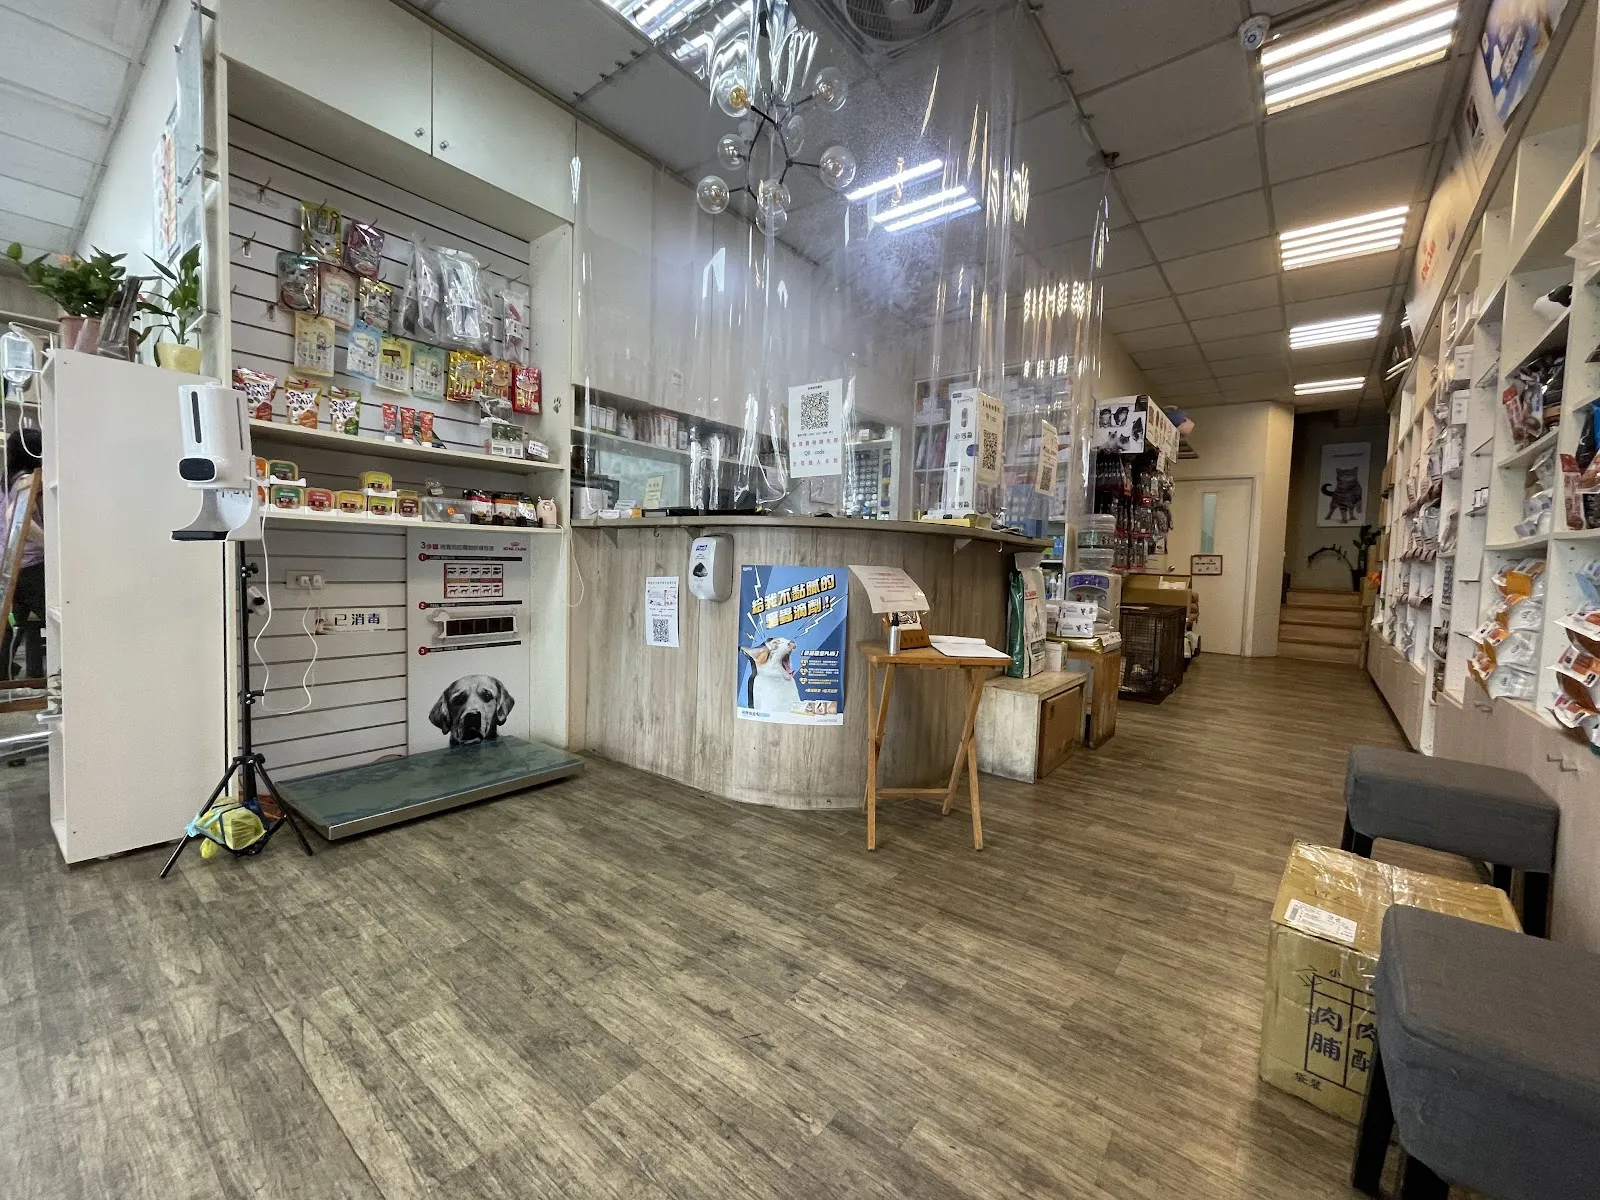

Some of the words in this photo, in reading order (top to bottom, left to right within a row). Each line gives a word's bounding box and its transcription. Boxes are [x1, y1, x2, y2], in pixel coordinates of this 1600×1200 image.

[295, 398, 314, 406] Mix
[334, 613, 381, 626] 已消毒
[1311, 1006, 1344, 1061] 肉脯
